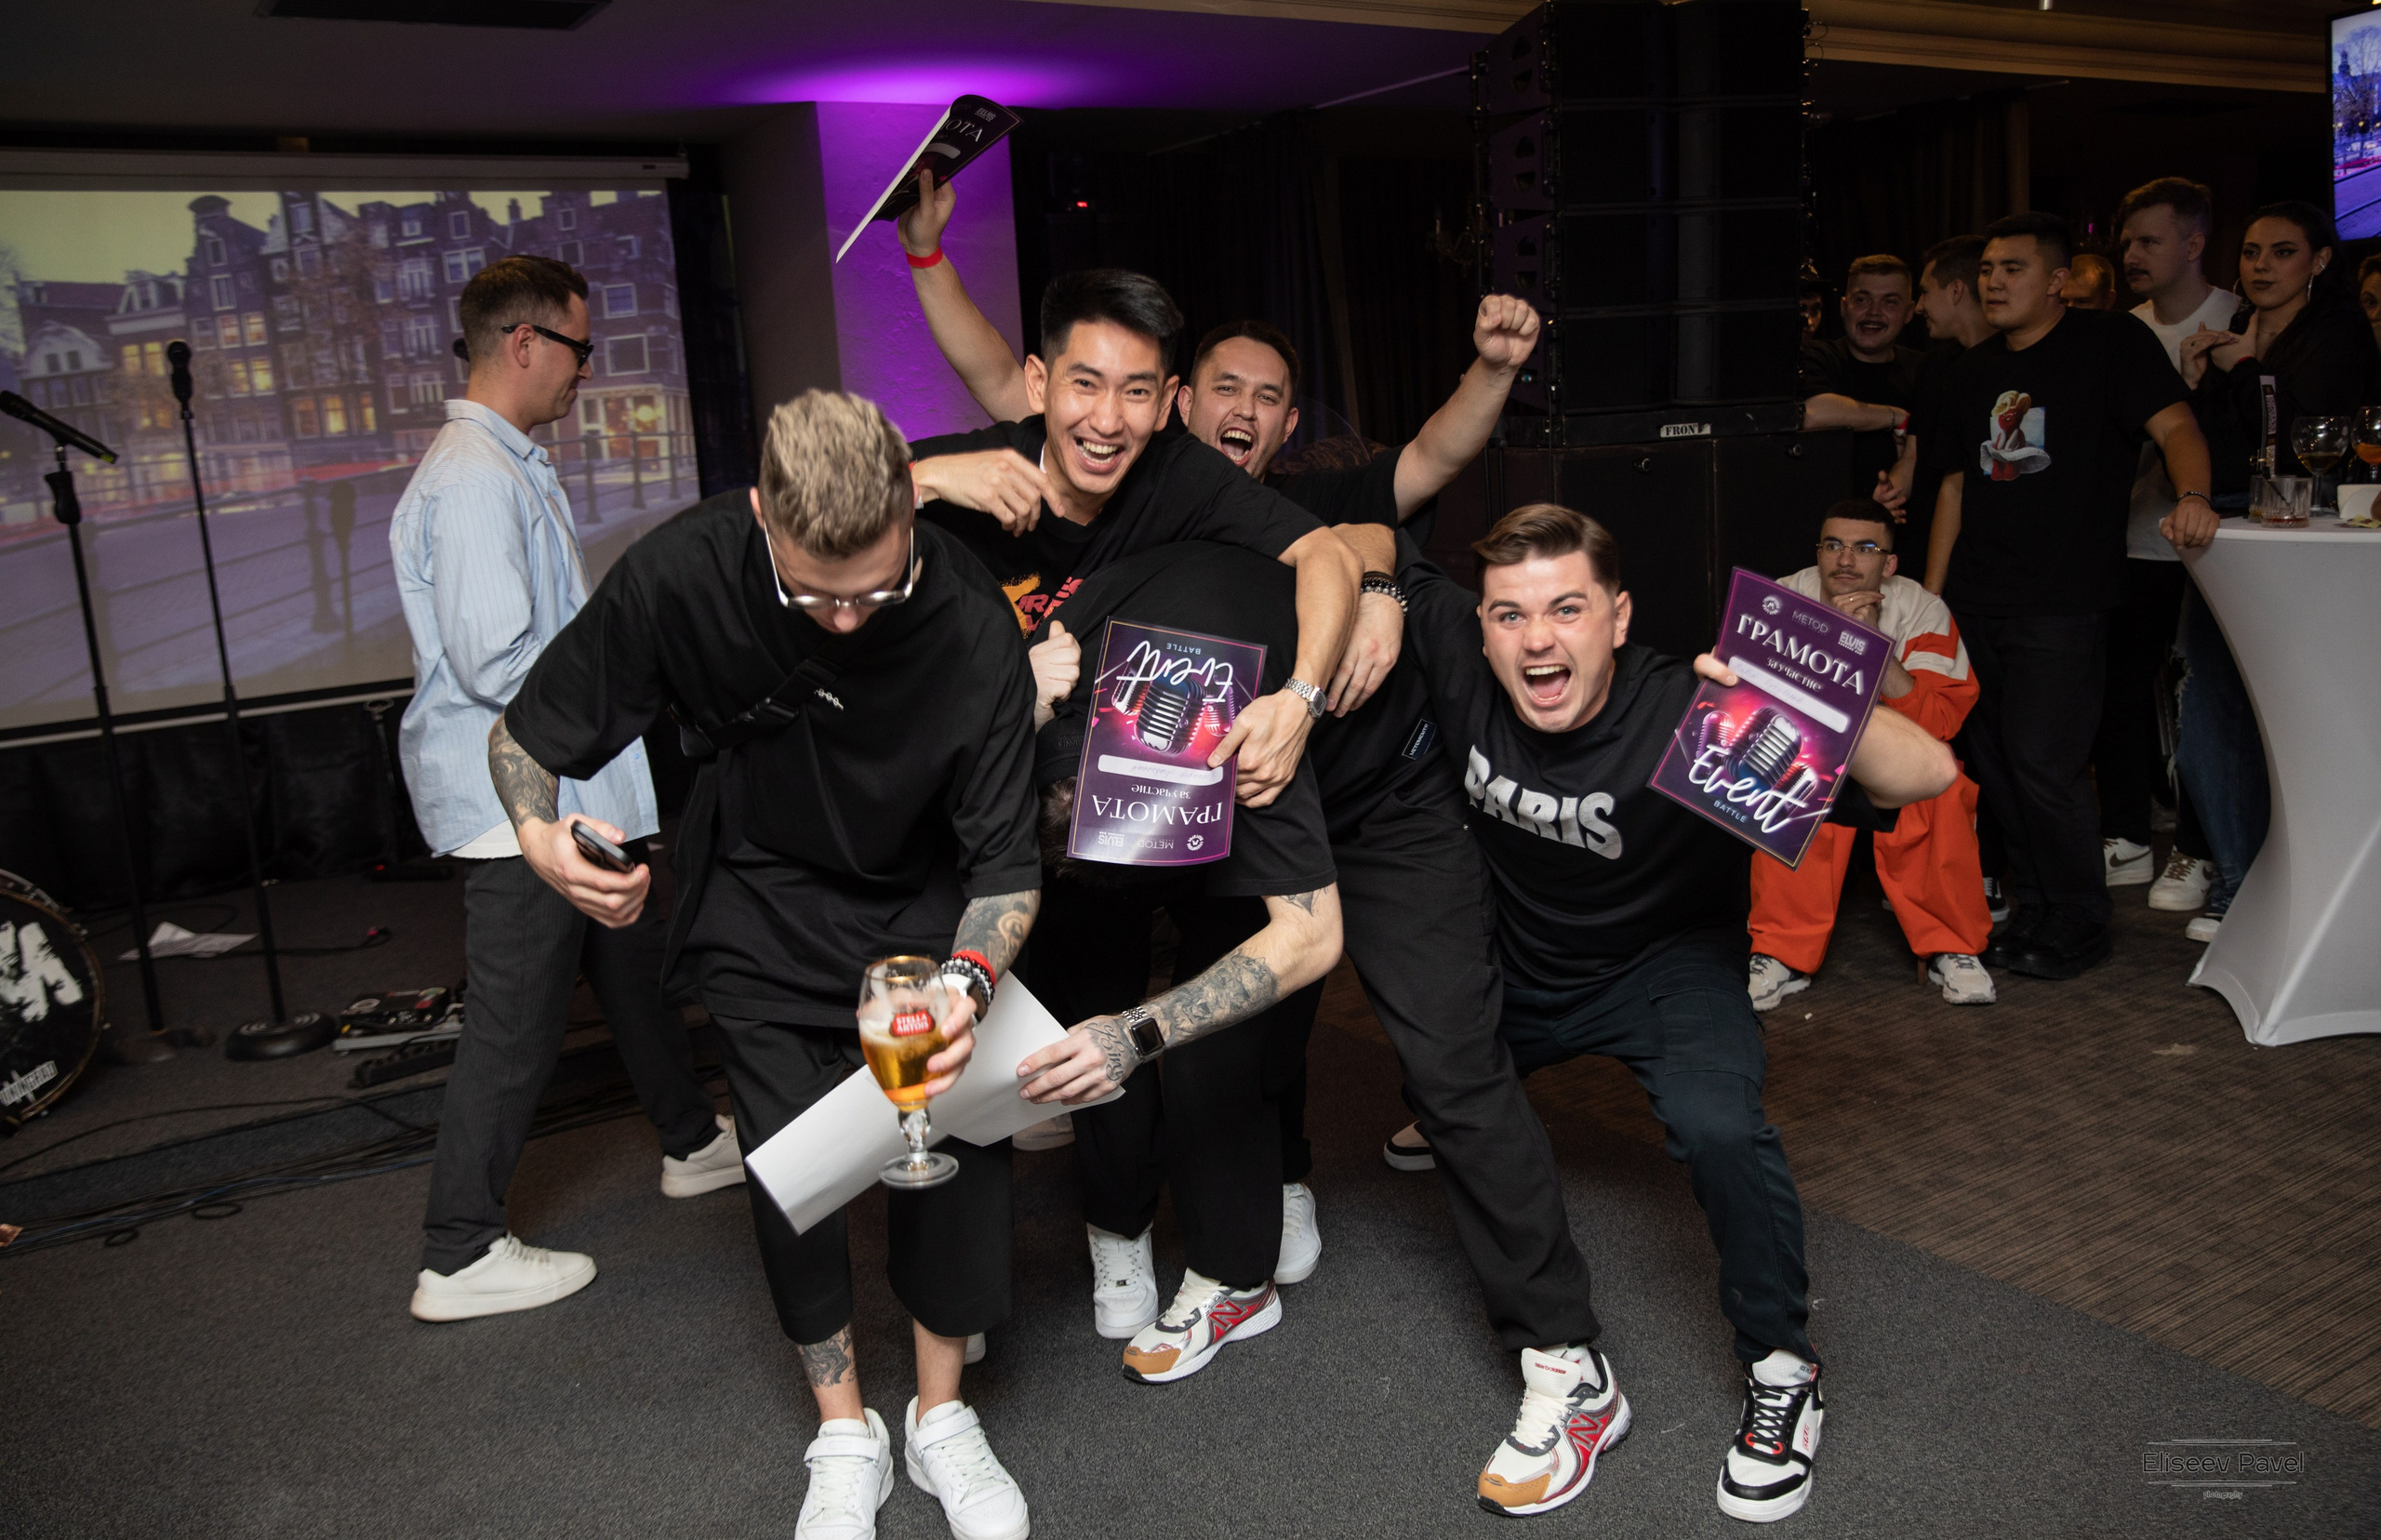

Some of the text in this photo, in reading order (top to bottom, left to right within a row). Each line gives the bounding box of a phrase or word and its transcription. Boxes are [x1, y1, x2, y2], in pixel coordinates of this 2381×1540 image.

[1791, 610, 1829, 633] METOD
[1165, 643, 1202, 655] BATTLE
[1839, 631, 1866, 650] ELVIS
[1736, 613, 1865, 696] ГРАМОТА
[1099, 640, 1234, 702] Event
[1131, 784, 1191, 800] за участие
[1687, 744, 1828, 833] Event
[1091, 795, 1224, 826] ГРАМОТА
[1464, 744, 1623, 860] PARIS
[1712, 799, 1748, 823] BATTLE
[1097, 834, 1124, 847] ELVIS
[1137, 839, 1174, 849] METOD
[896, 1014, 927, 1024] STELLA
[897, 1021, 928, 1031] ARTOIS
